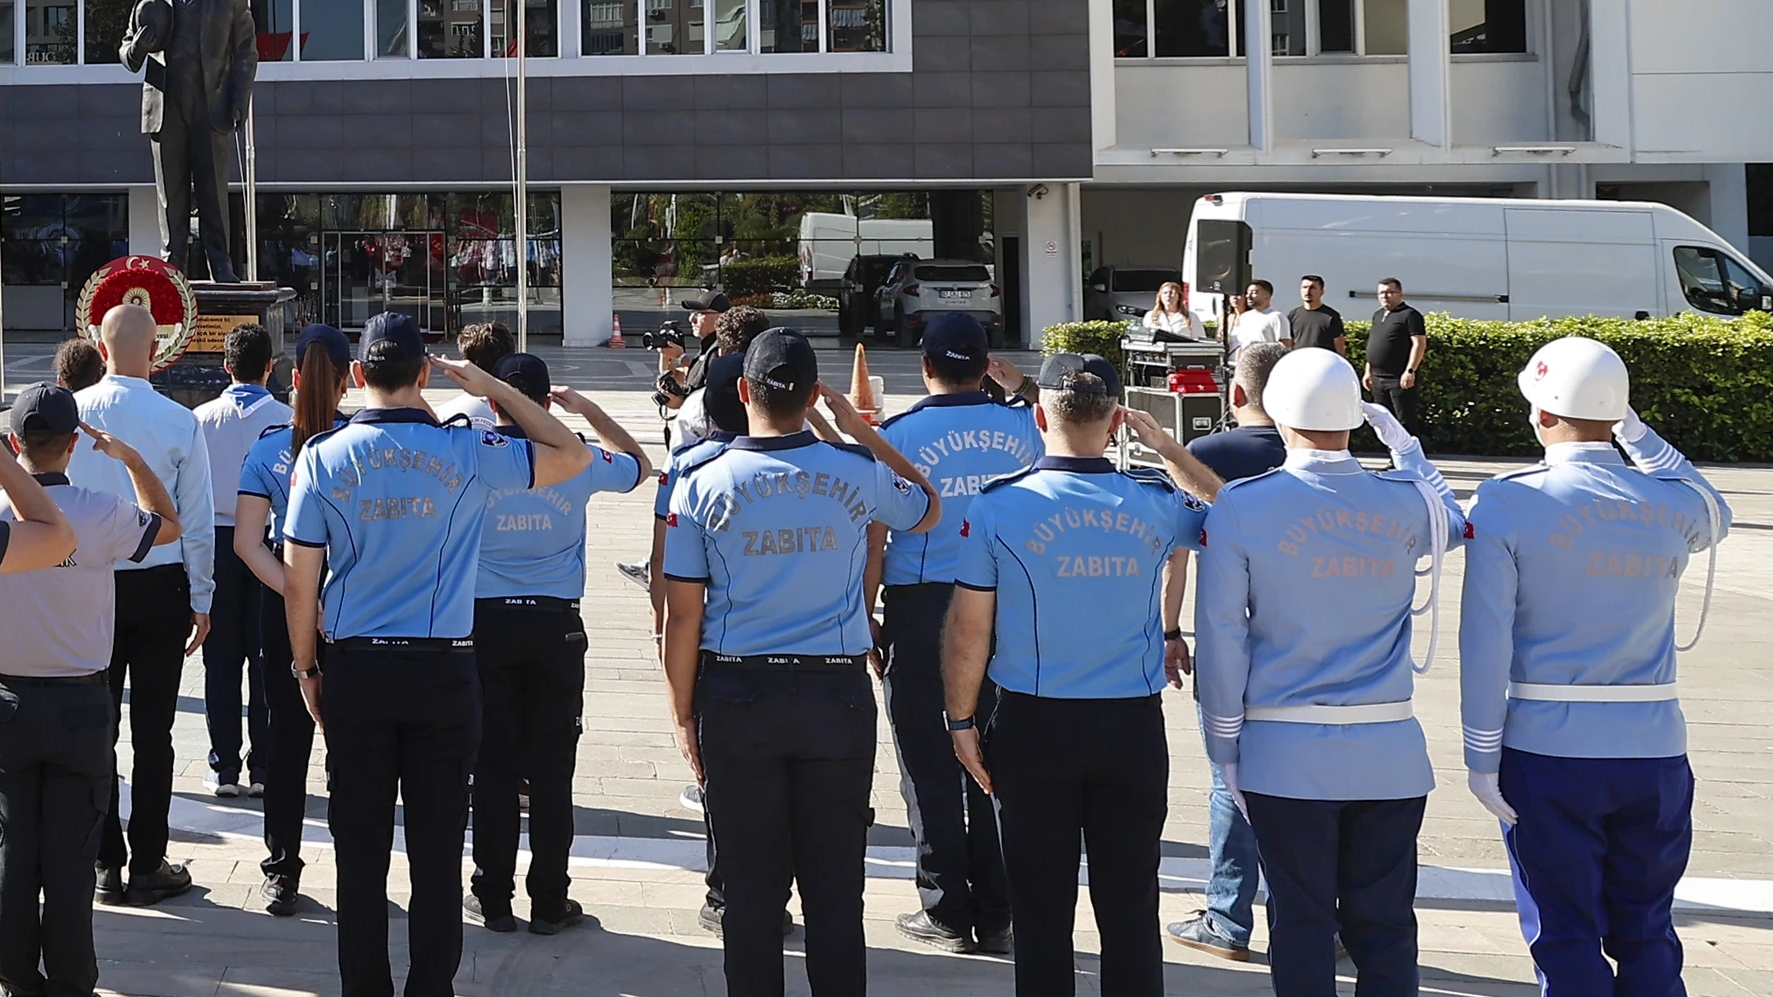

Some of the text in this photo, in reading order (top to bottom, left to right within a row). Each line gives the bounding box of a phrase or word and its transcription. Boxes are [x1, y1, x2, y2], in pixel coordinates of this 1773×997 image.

[941, 474, 999, 498] ZABI
[360, 497, 436, 521] ZABITA
[709, 471, 866, 532] BÜYÜKŞEHİR
[497, 513, 553, 531] ZABITA
[1025, 506, 1162, 555] BÜYÜKŞEHİR
[1278, 507, 1417, 554] BÜYÜKŞEHİR
[743, 526, 838, 556] ZABITA
[1057, 555, 1139, 578] ZABITA
[1310, 556, 1396, 579] ZABITA
[1583, 552, 1679, 579] ZABITA
[716, 655, 742, 663] ZABITA
[825, 657, 853, 665] ZABITA
